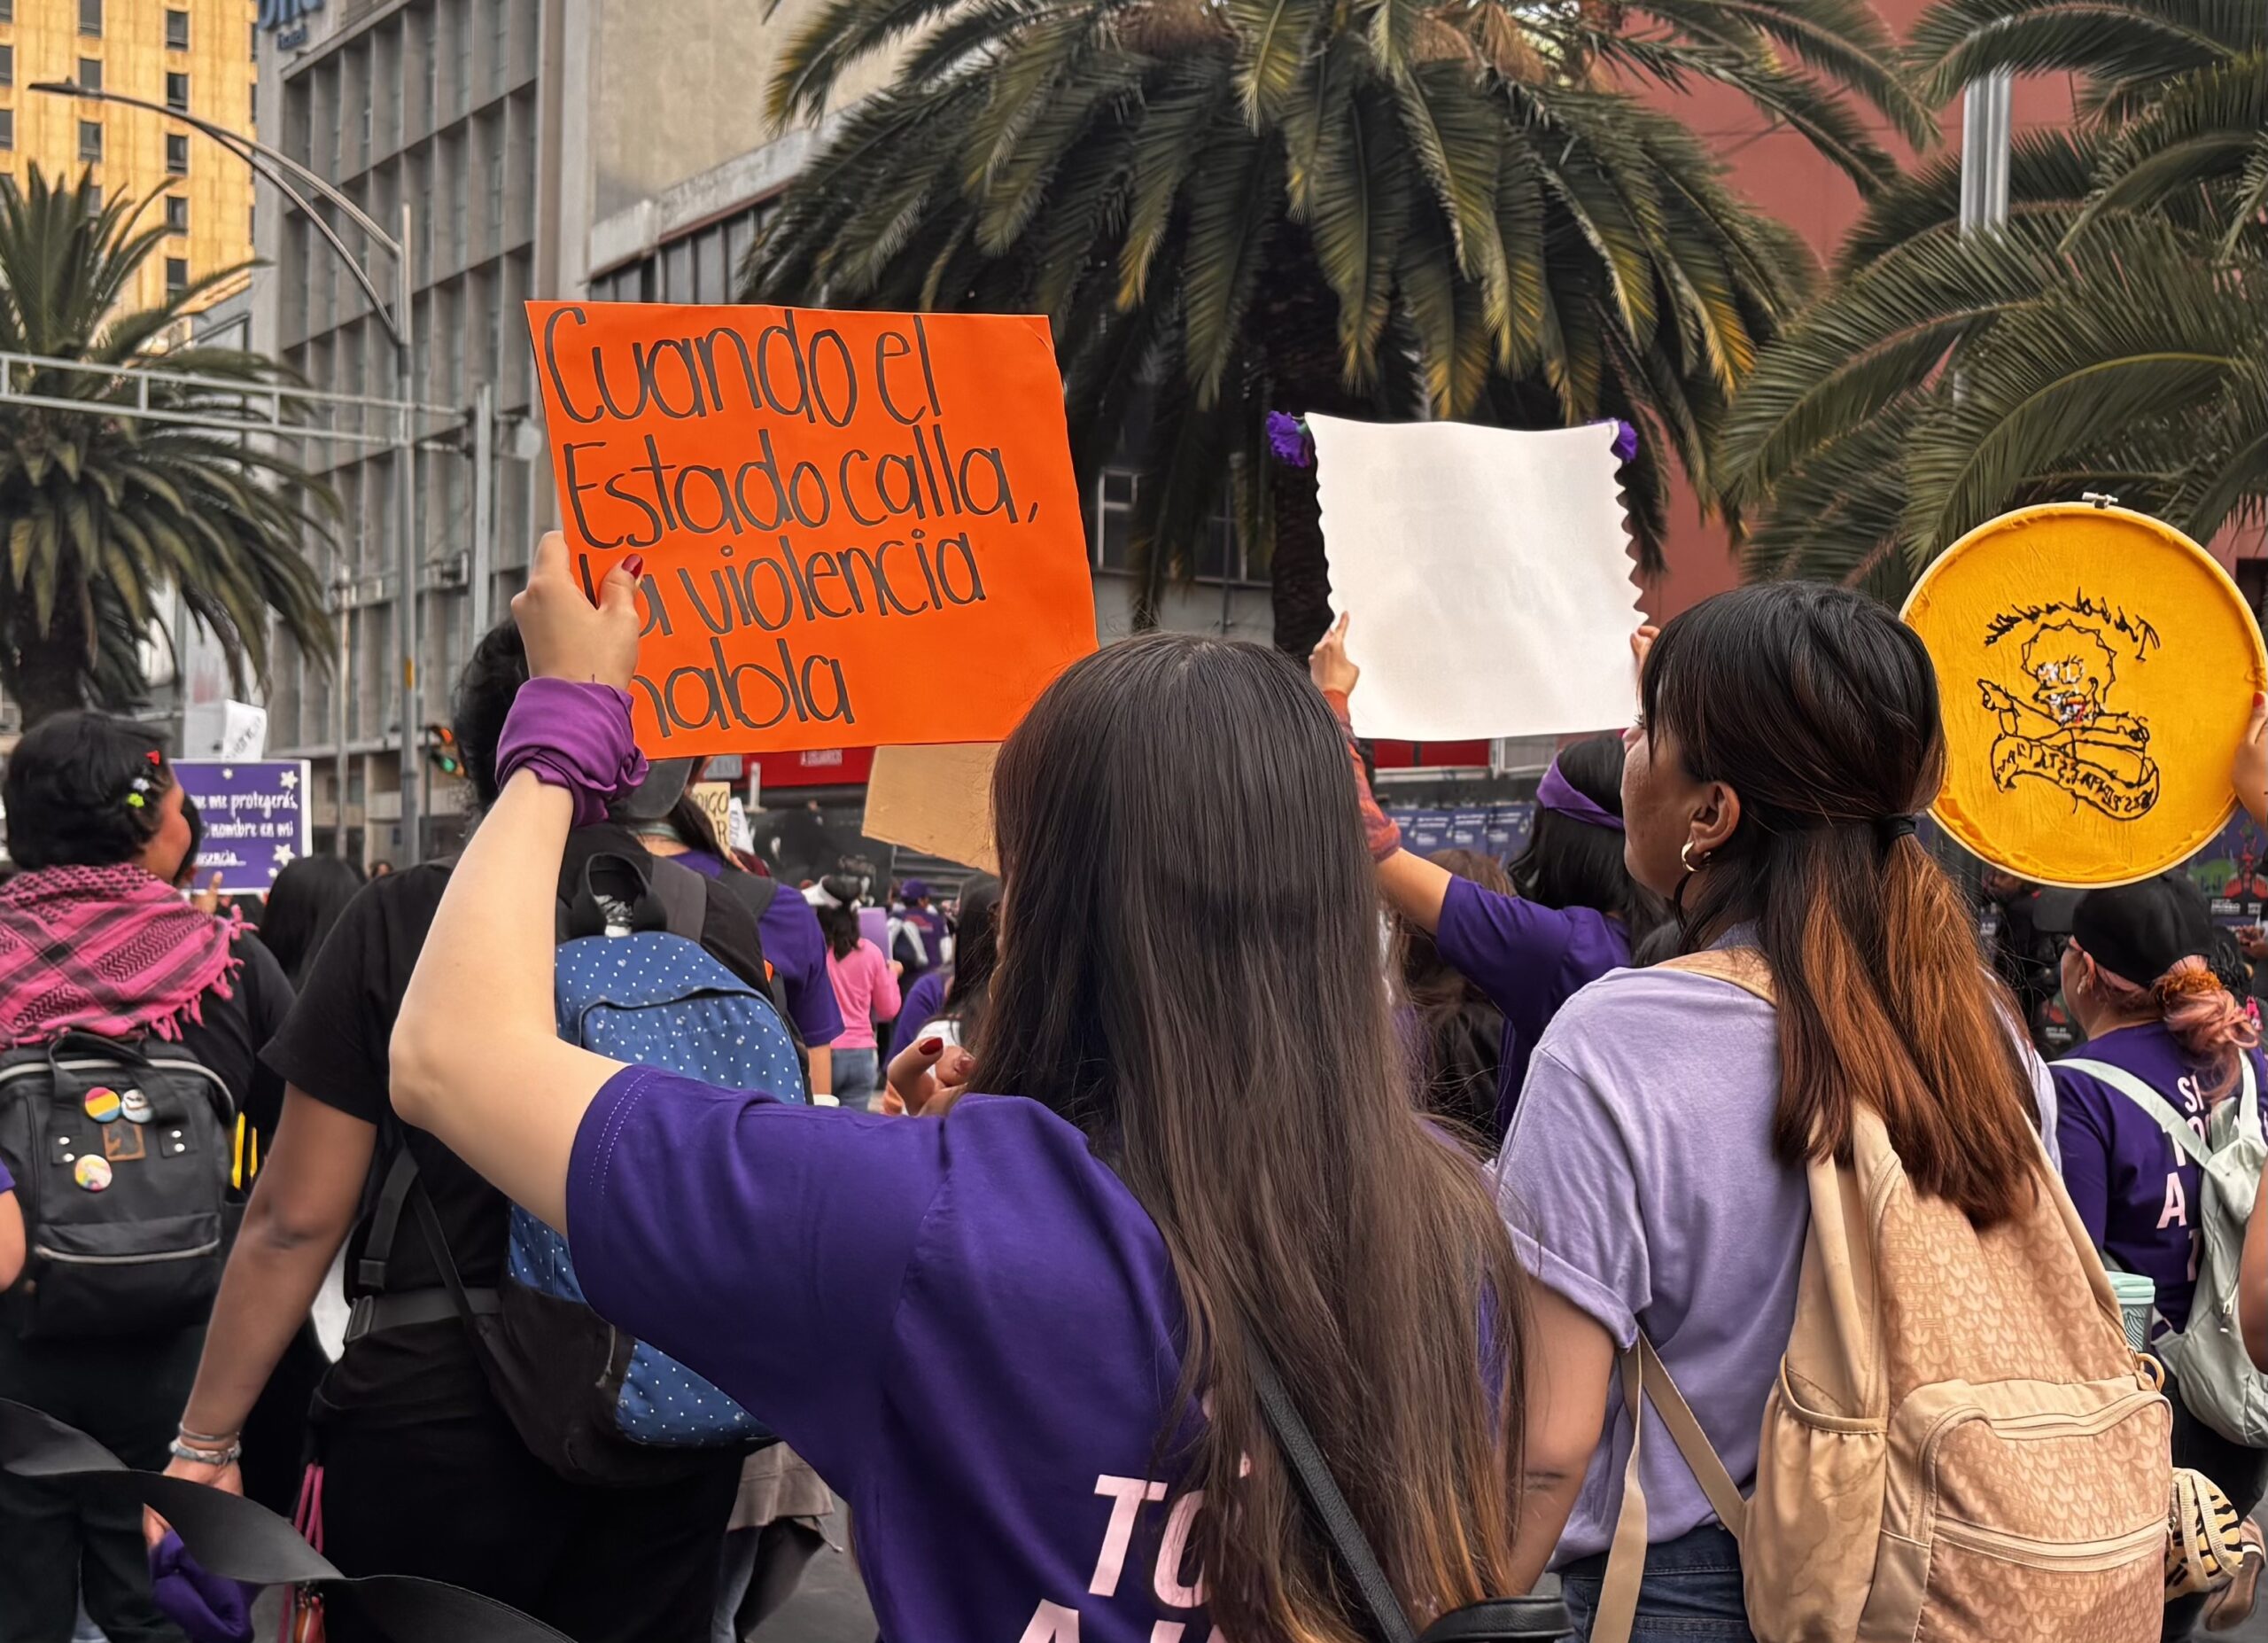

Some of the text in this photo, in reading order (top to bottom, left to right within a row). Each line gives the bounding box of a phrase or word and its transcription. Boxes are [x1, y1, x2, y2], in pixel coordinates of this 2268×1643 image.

[544, 307, 943, 427] Cuando el
[563, 424, 1038, 549] Estado calla,
[677, 529, 987, 635] violencia
